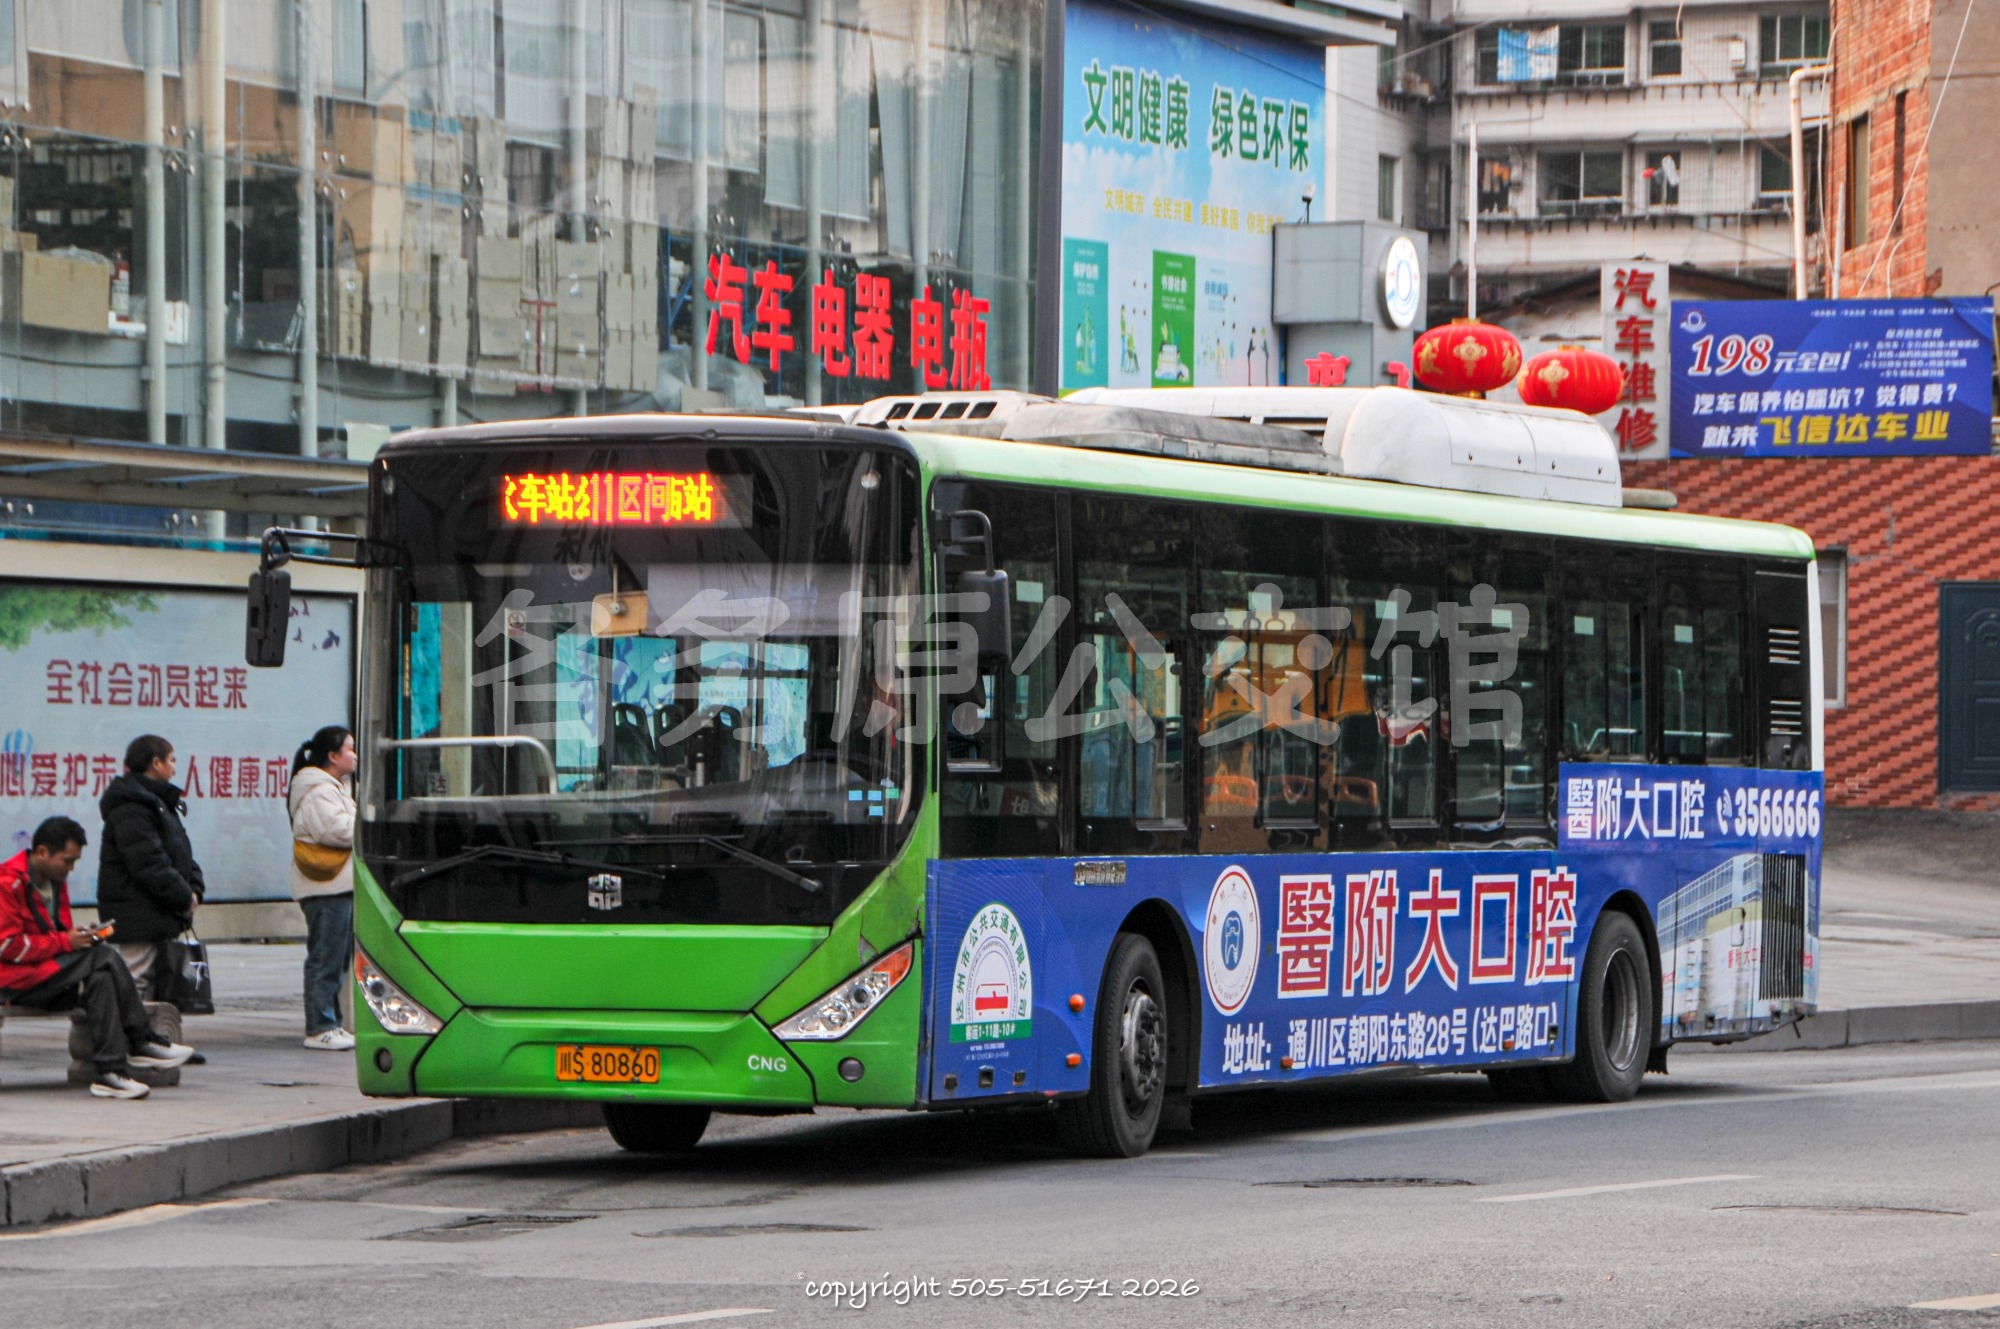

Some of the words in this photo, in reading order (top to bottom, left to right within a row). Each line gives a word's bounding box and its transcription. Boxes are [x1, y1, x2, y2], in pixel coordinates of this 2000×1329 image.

[1083, 59, 1189, 150] 文明健康
[1211, 83, 1310, 172] 绿色环保
[1153, 196, 1193, 224] 全民共建
[1201, 203, 1239, 231] 美好家园
[704, 252, 795, 372] 汽车
[812, 269, 894, 381] 电器
[911, 285, 991, 390] 电瓶
[1614, 268, 1657, 451] 汽车维修
[47, 660, 247, 709] 全社会动员起来
[1567, 777, 1705, 840] 醫附大口腔
[1734, 787, 1820, 838] 3566666
[955, 908, 1028, 1022] 达州市公共交通有限公司
[1277, 866, 1578, 999] 醫附大口腔
[748, 1055, 787, 1072] CNG
